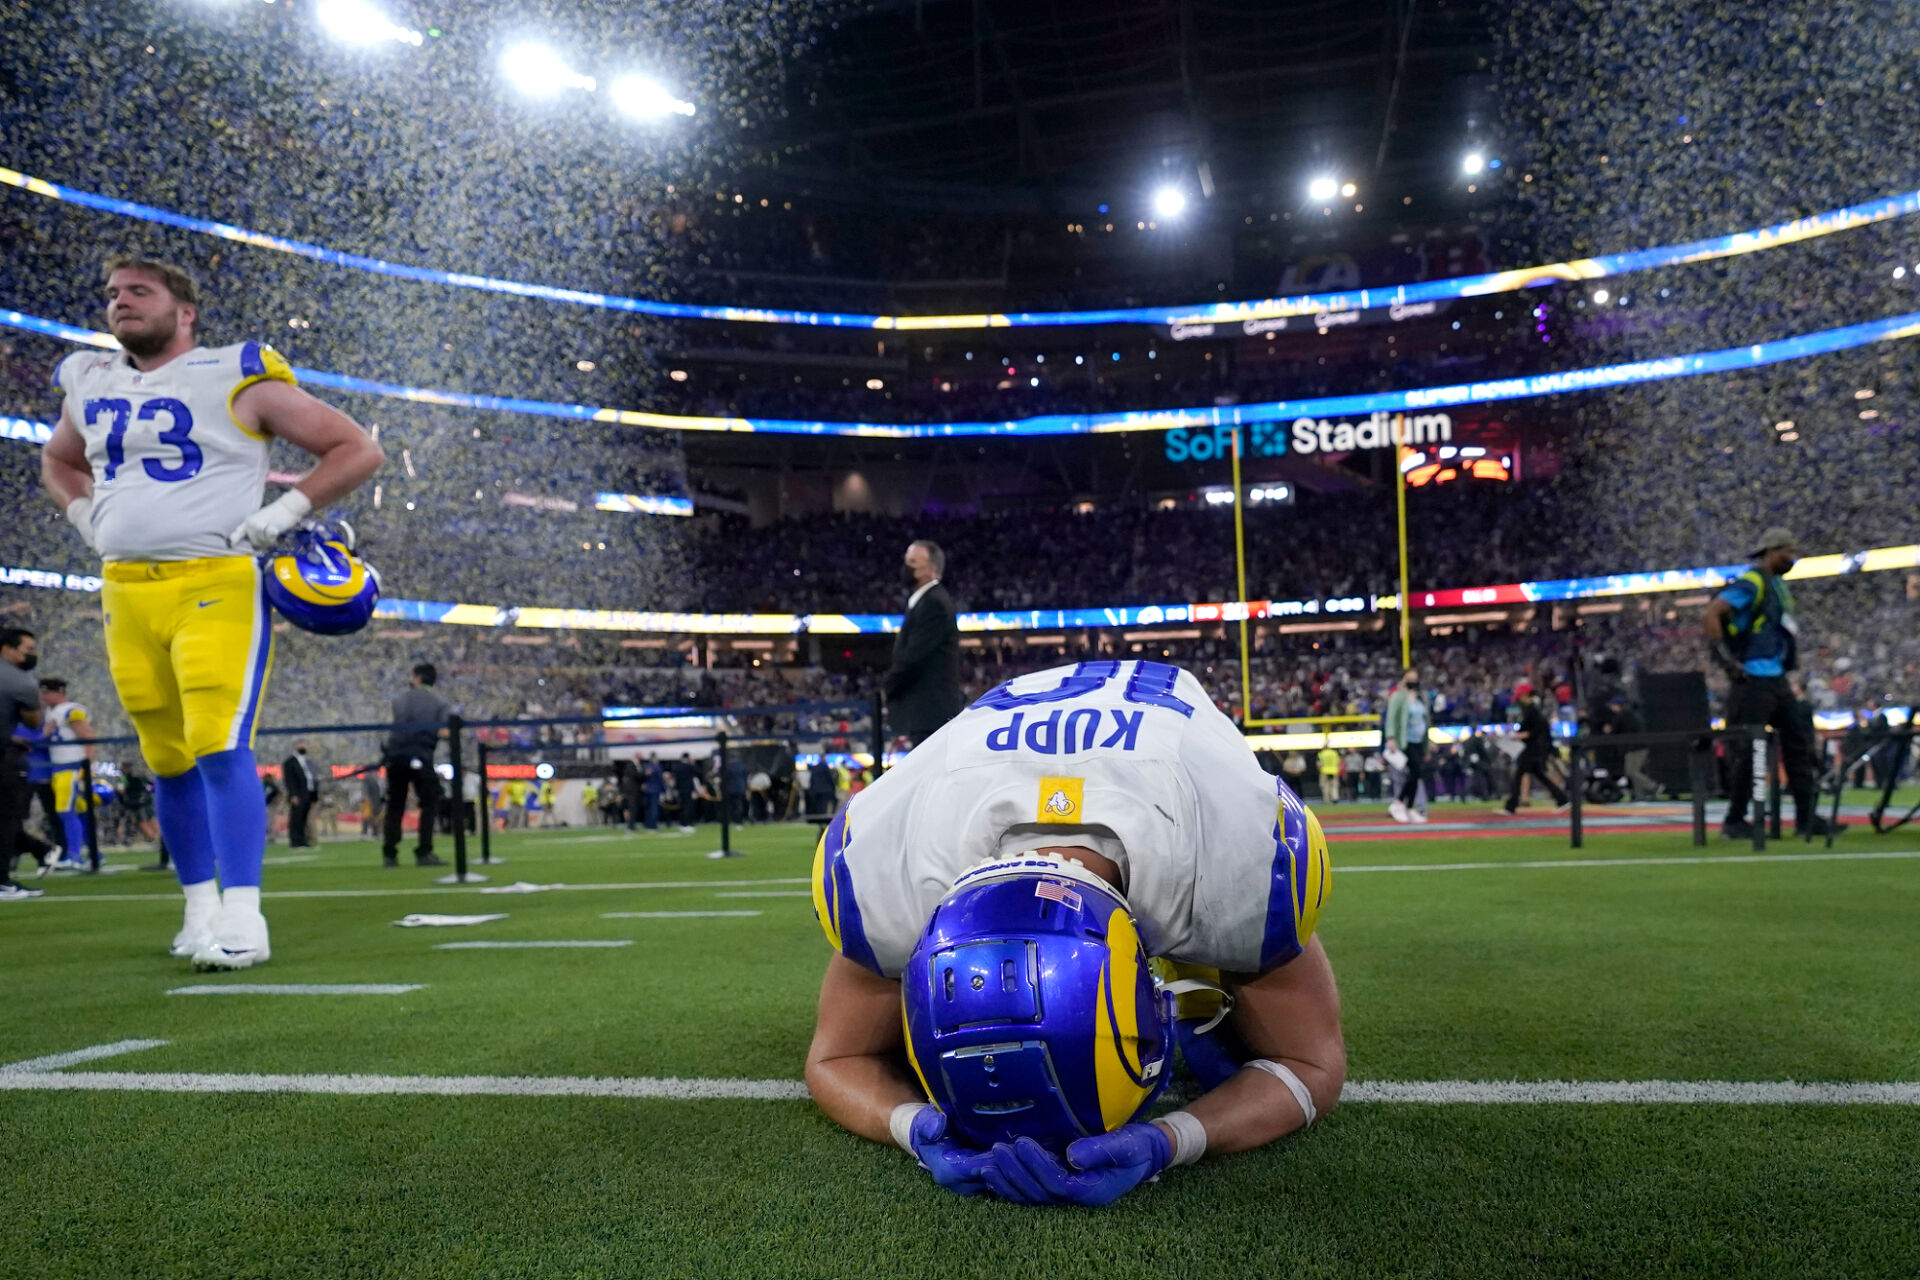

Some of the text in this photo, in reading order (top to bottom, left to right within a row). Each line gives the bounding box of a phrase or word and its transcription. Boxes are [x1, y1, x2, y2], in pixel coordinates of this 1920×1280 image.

[1405, 385, 1470, 408] SUPER
[1471, 379, 1527, 400] BOWL
[84, 397, 203, 484] 73
[1165, 411, 1453, 461] SoFi Stadium
[65, 574, 104, 592] BO
[985, 708, 1144, 755] KUPP
